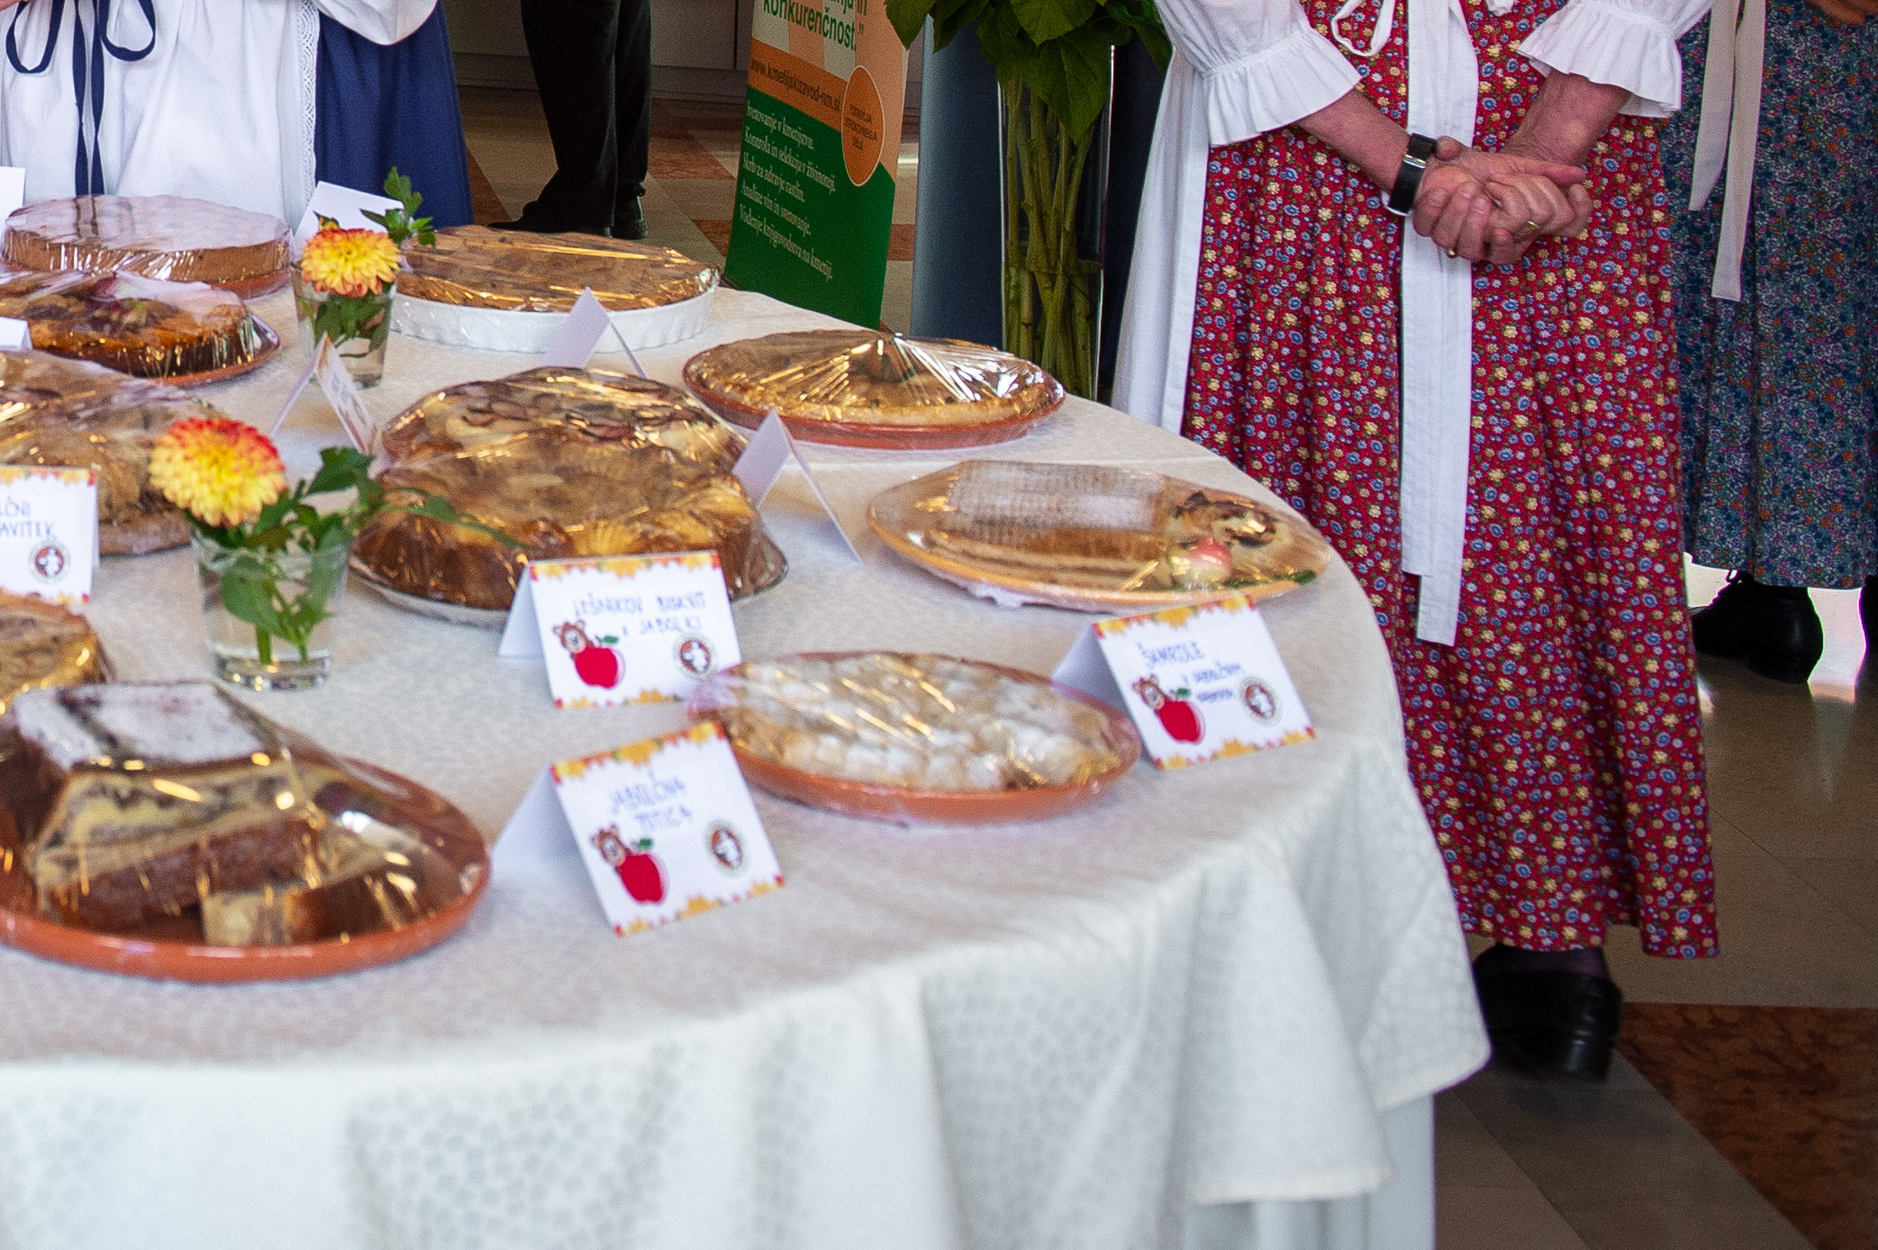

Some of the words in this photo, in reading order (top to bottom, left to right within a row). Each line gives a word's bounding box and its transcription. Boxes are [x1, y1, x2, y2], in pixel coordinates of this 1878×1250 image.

[764, 165, 786, 194] zdravje
[741, 180, 763, 205] Analize
[763, 193, 773, 211] vin
[739, 203, 762, 236] Vodenje
[573, 593, 643, 618] LEŠNIKOV
[656, 590, 707, 613] BISKVIT
[640, 616, 702, 635] JABOLKI
